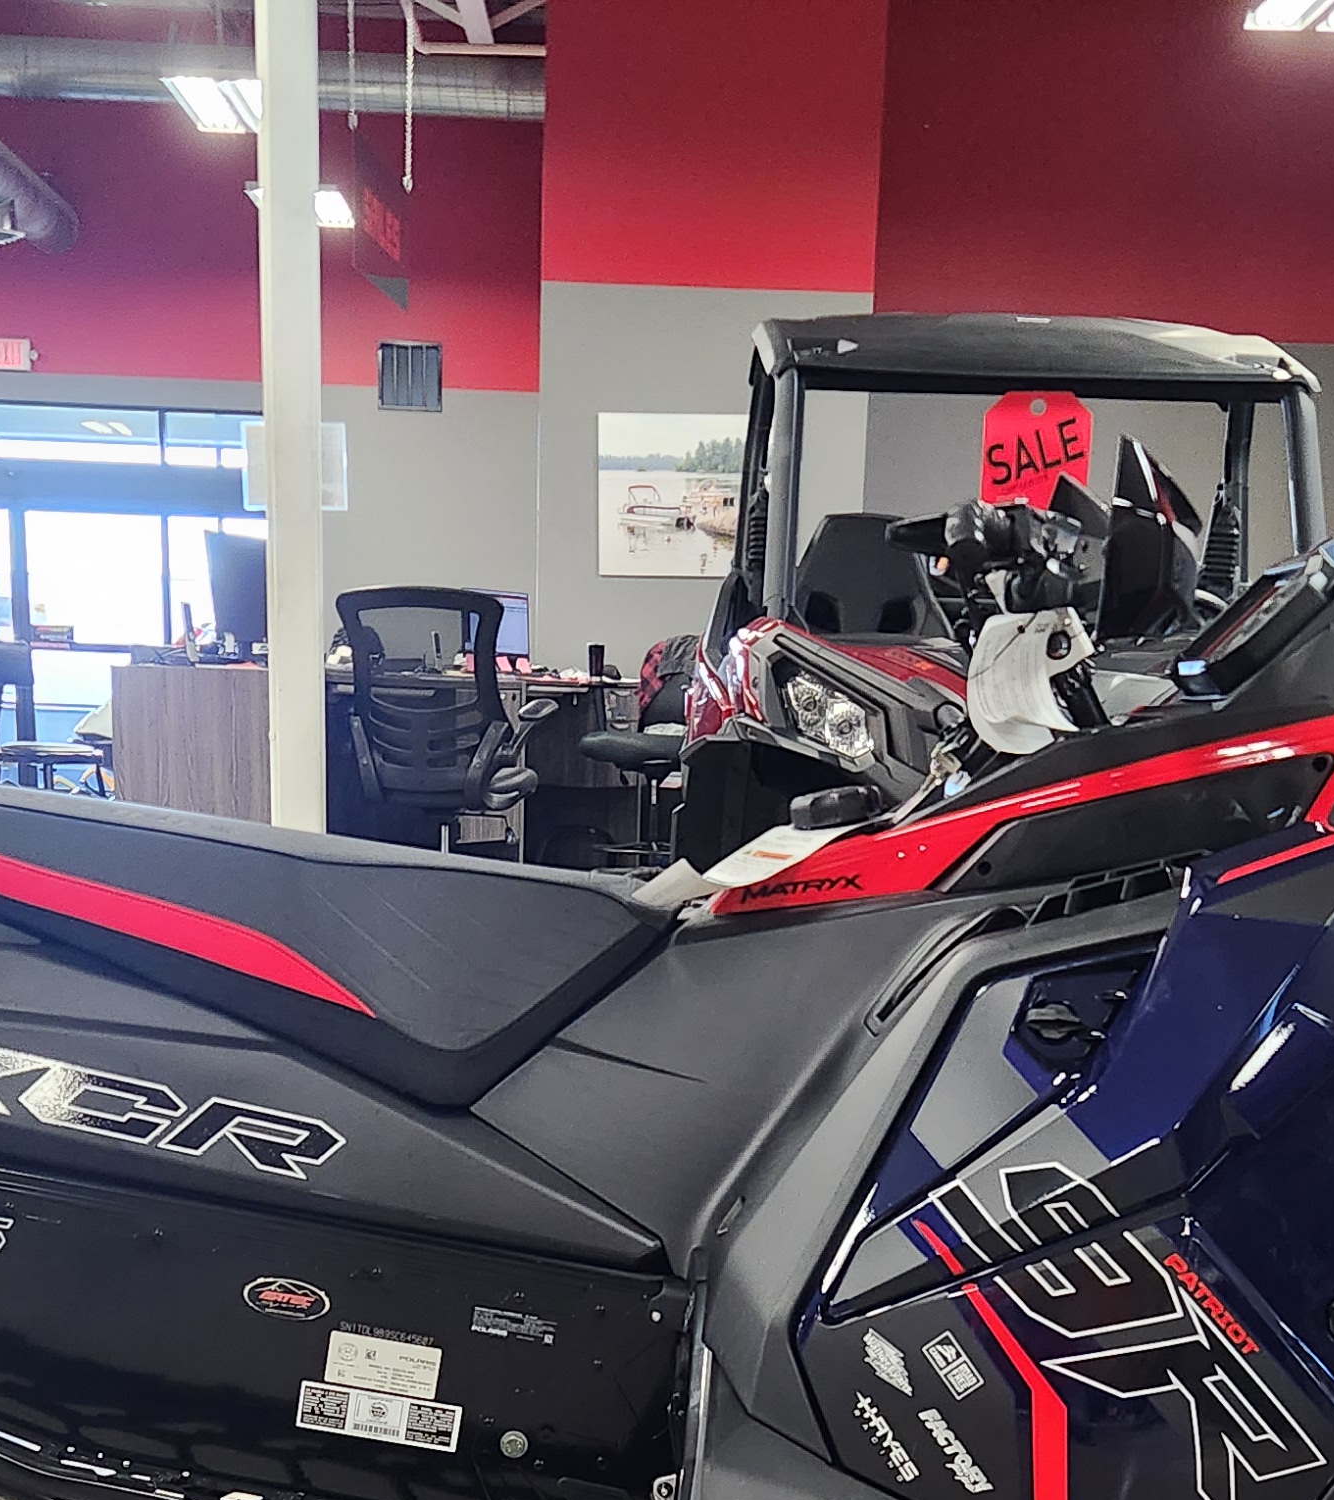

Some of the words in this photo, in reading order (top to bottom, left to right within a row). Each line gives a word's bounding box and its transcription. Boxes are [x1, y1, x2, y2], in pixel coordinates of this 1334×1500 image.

[987, 418, 1085, 486] SALE
[741, 874, 863, 904] MATRYX
[1163, 1252, 1260, 1354] PATRIOT
[856, 1390, 920, 1482] HAYES
[918, 1408, 995, 1490] FACTORY
